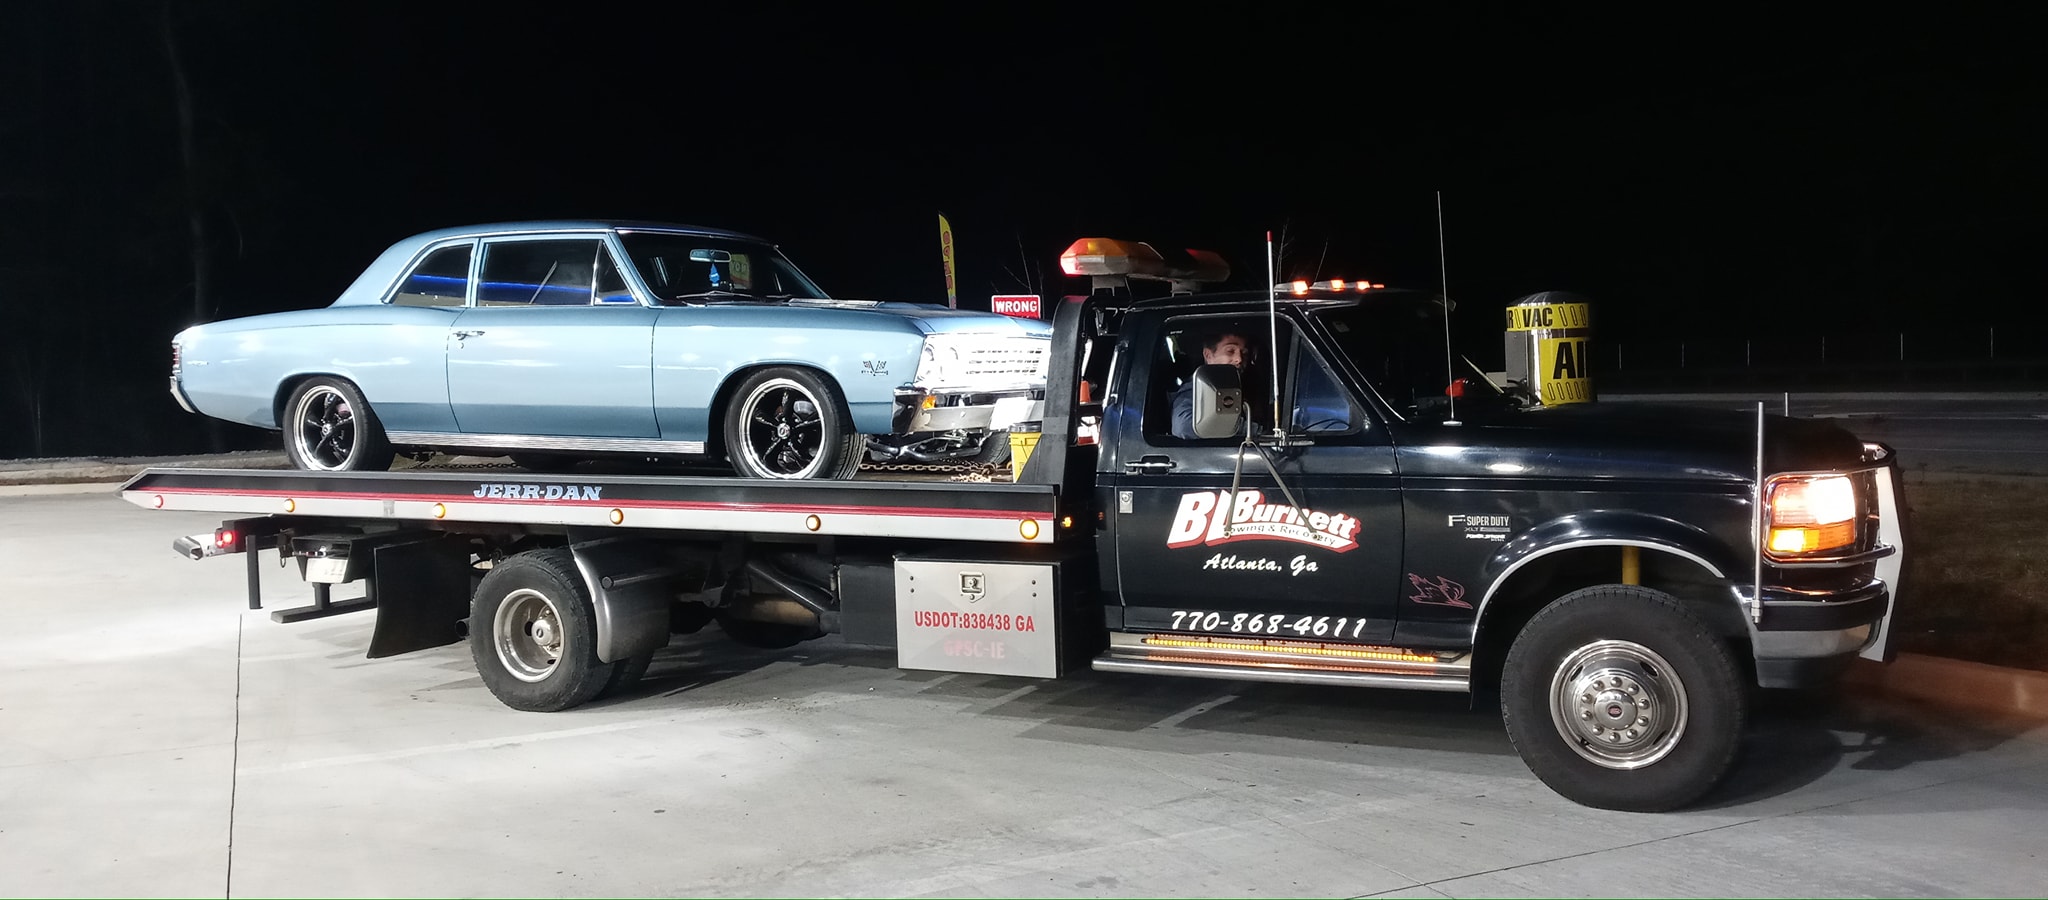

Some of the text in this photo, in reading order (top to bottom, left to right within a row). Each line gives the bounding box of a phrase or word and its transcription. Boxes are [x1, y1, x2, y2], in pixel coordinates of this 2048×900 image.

[995, 300, 1038, 312] WRONG
[1522, 307, 1553, 328] VAC
[473, 484, 602, 501] JERR-DAN
[1232, 490, 1360, 542] Burnett
[1466, 515, 1490, 526] SUPER
[1490, 516, 1510, 526] DUTY
[1203, 553, 1319, 577] Atlanta, Ga
[914, 611, 1035, 632] USDOT:838438 GA
[1171, 611, 1367, 638] 770-868-4611
